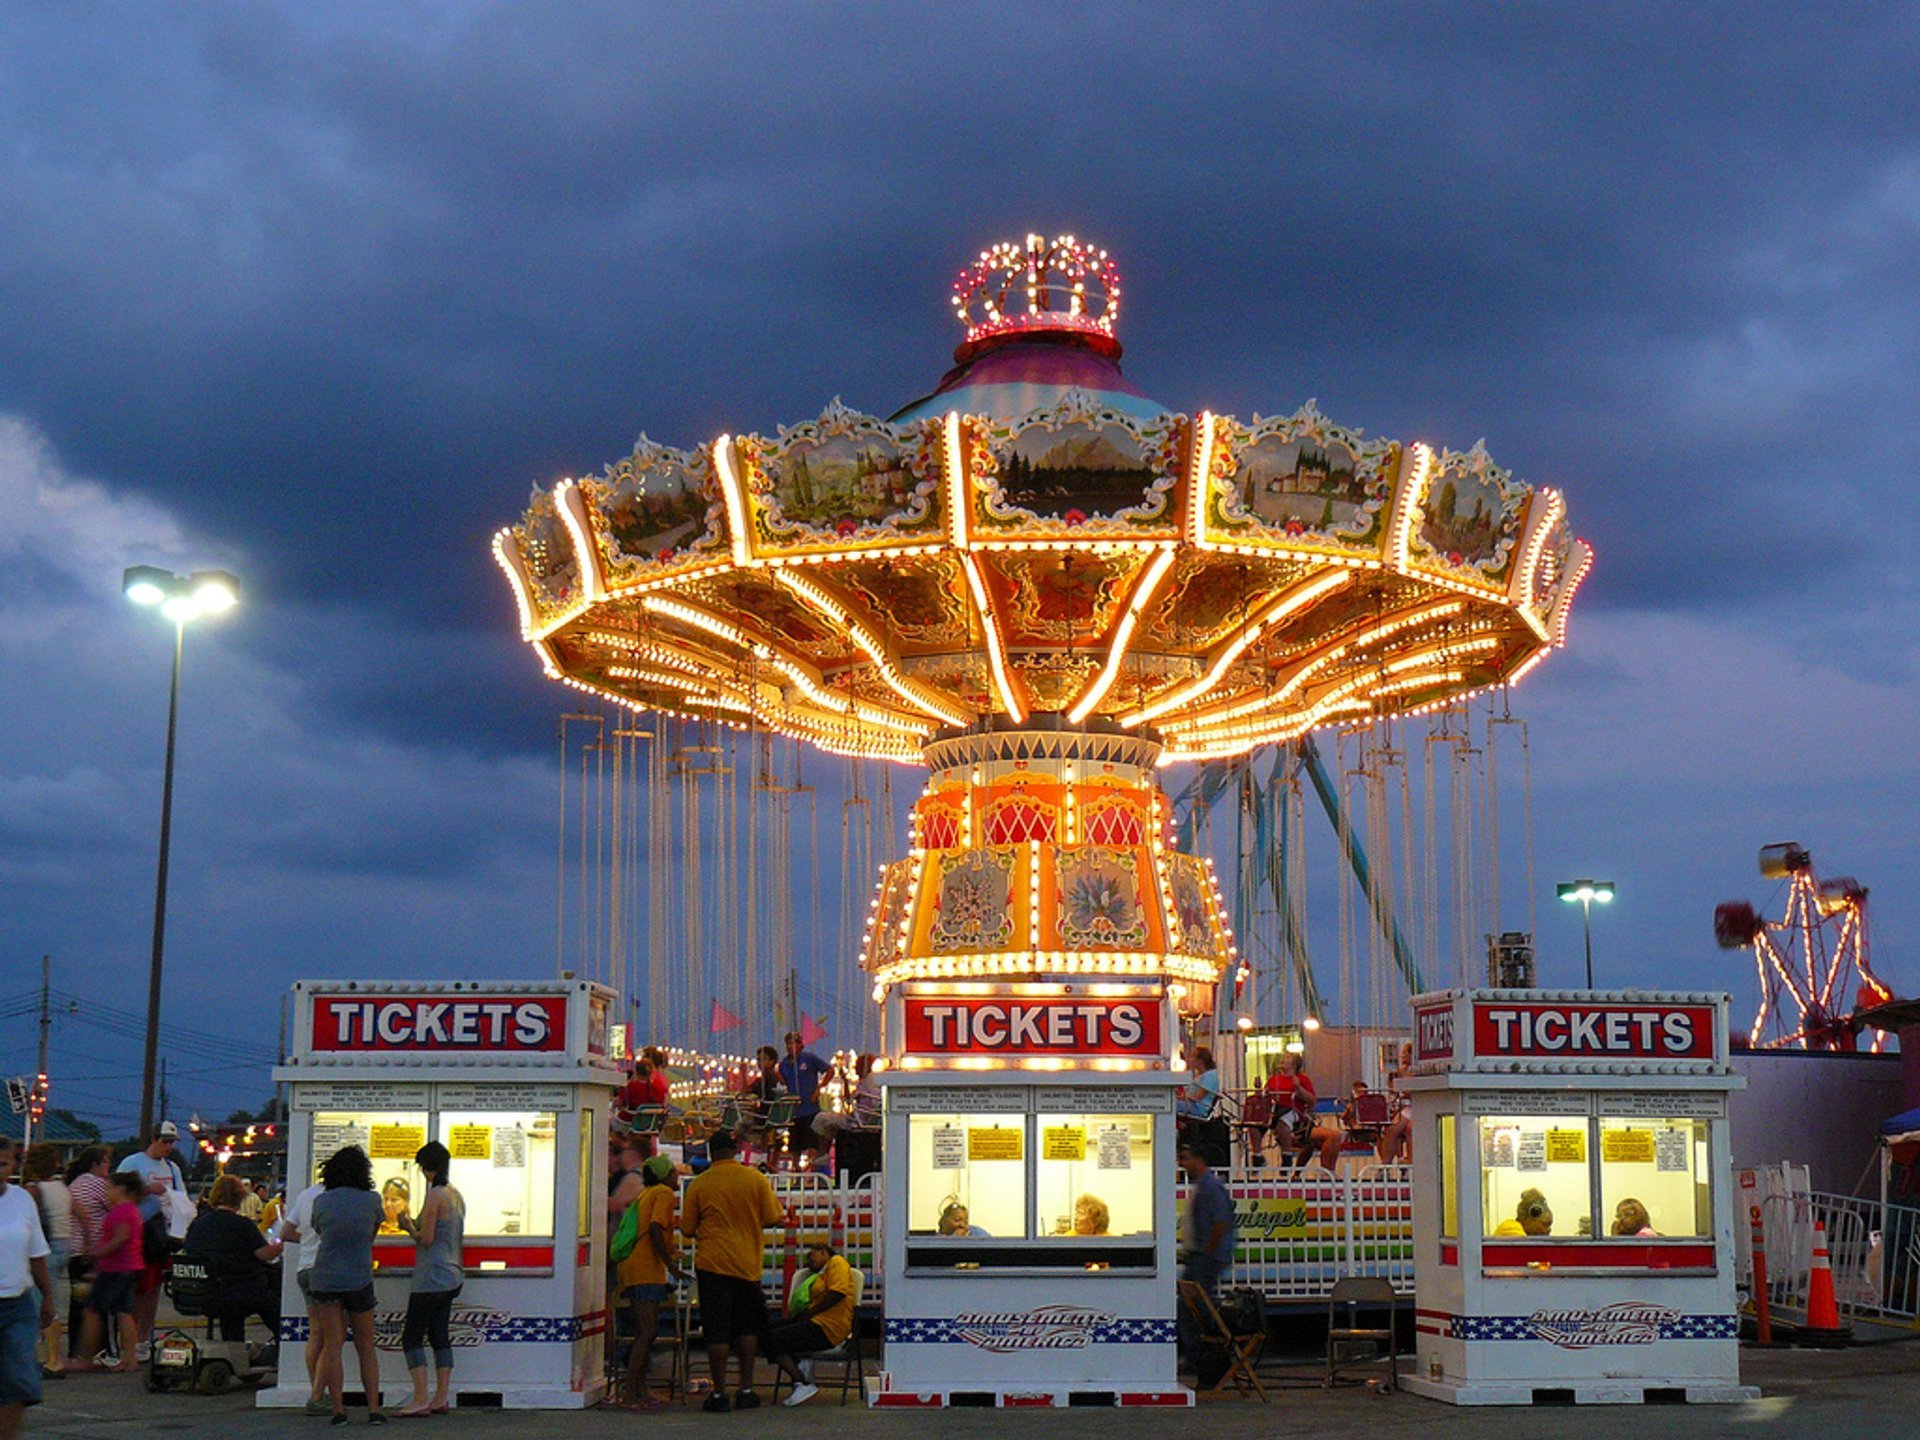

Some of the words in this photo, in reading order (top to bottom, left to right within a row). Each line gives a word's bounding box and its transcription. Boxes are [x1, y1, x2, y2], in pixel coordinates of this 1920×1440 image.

[330, 1003, 550, 1044] TICKETS
[923, 1005, 1142, 1046] TICKETS
[1489, 1010, 1693, 1051] TICKETS
[172, 1263, 208, 1278] RENTAL
[952, 1312, 1118, 1326] AMUSEMENTS
[1528, 1308, 1682, 1324] AMUSEMENTS
[977, 1333, 1093, 1349] AMERICA
[1553, 1330, 1660, 1346] AMERICA
